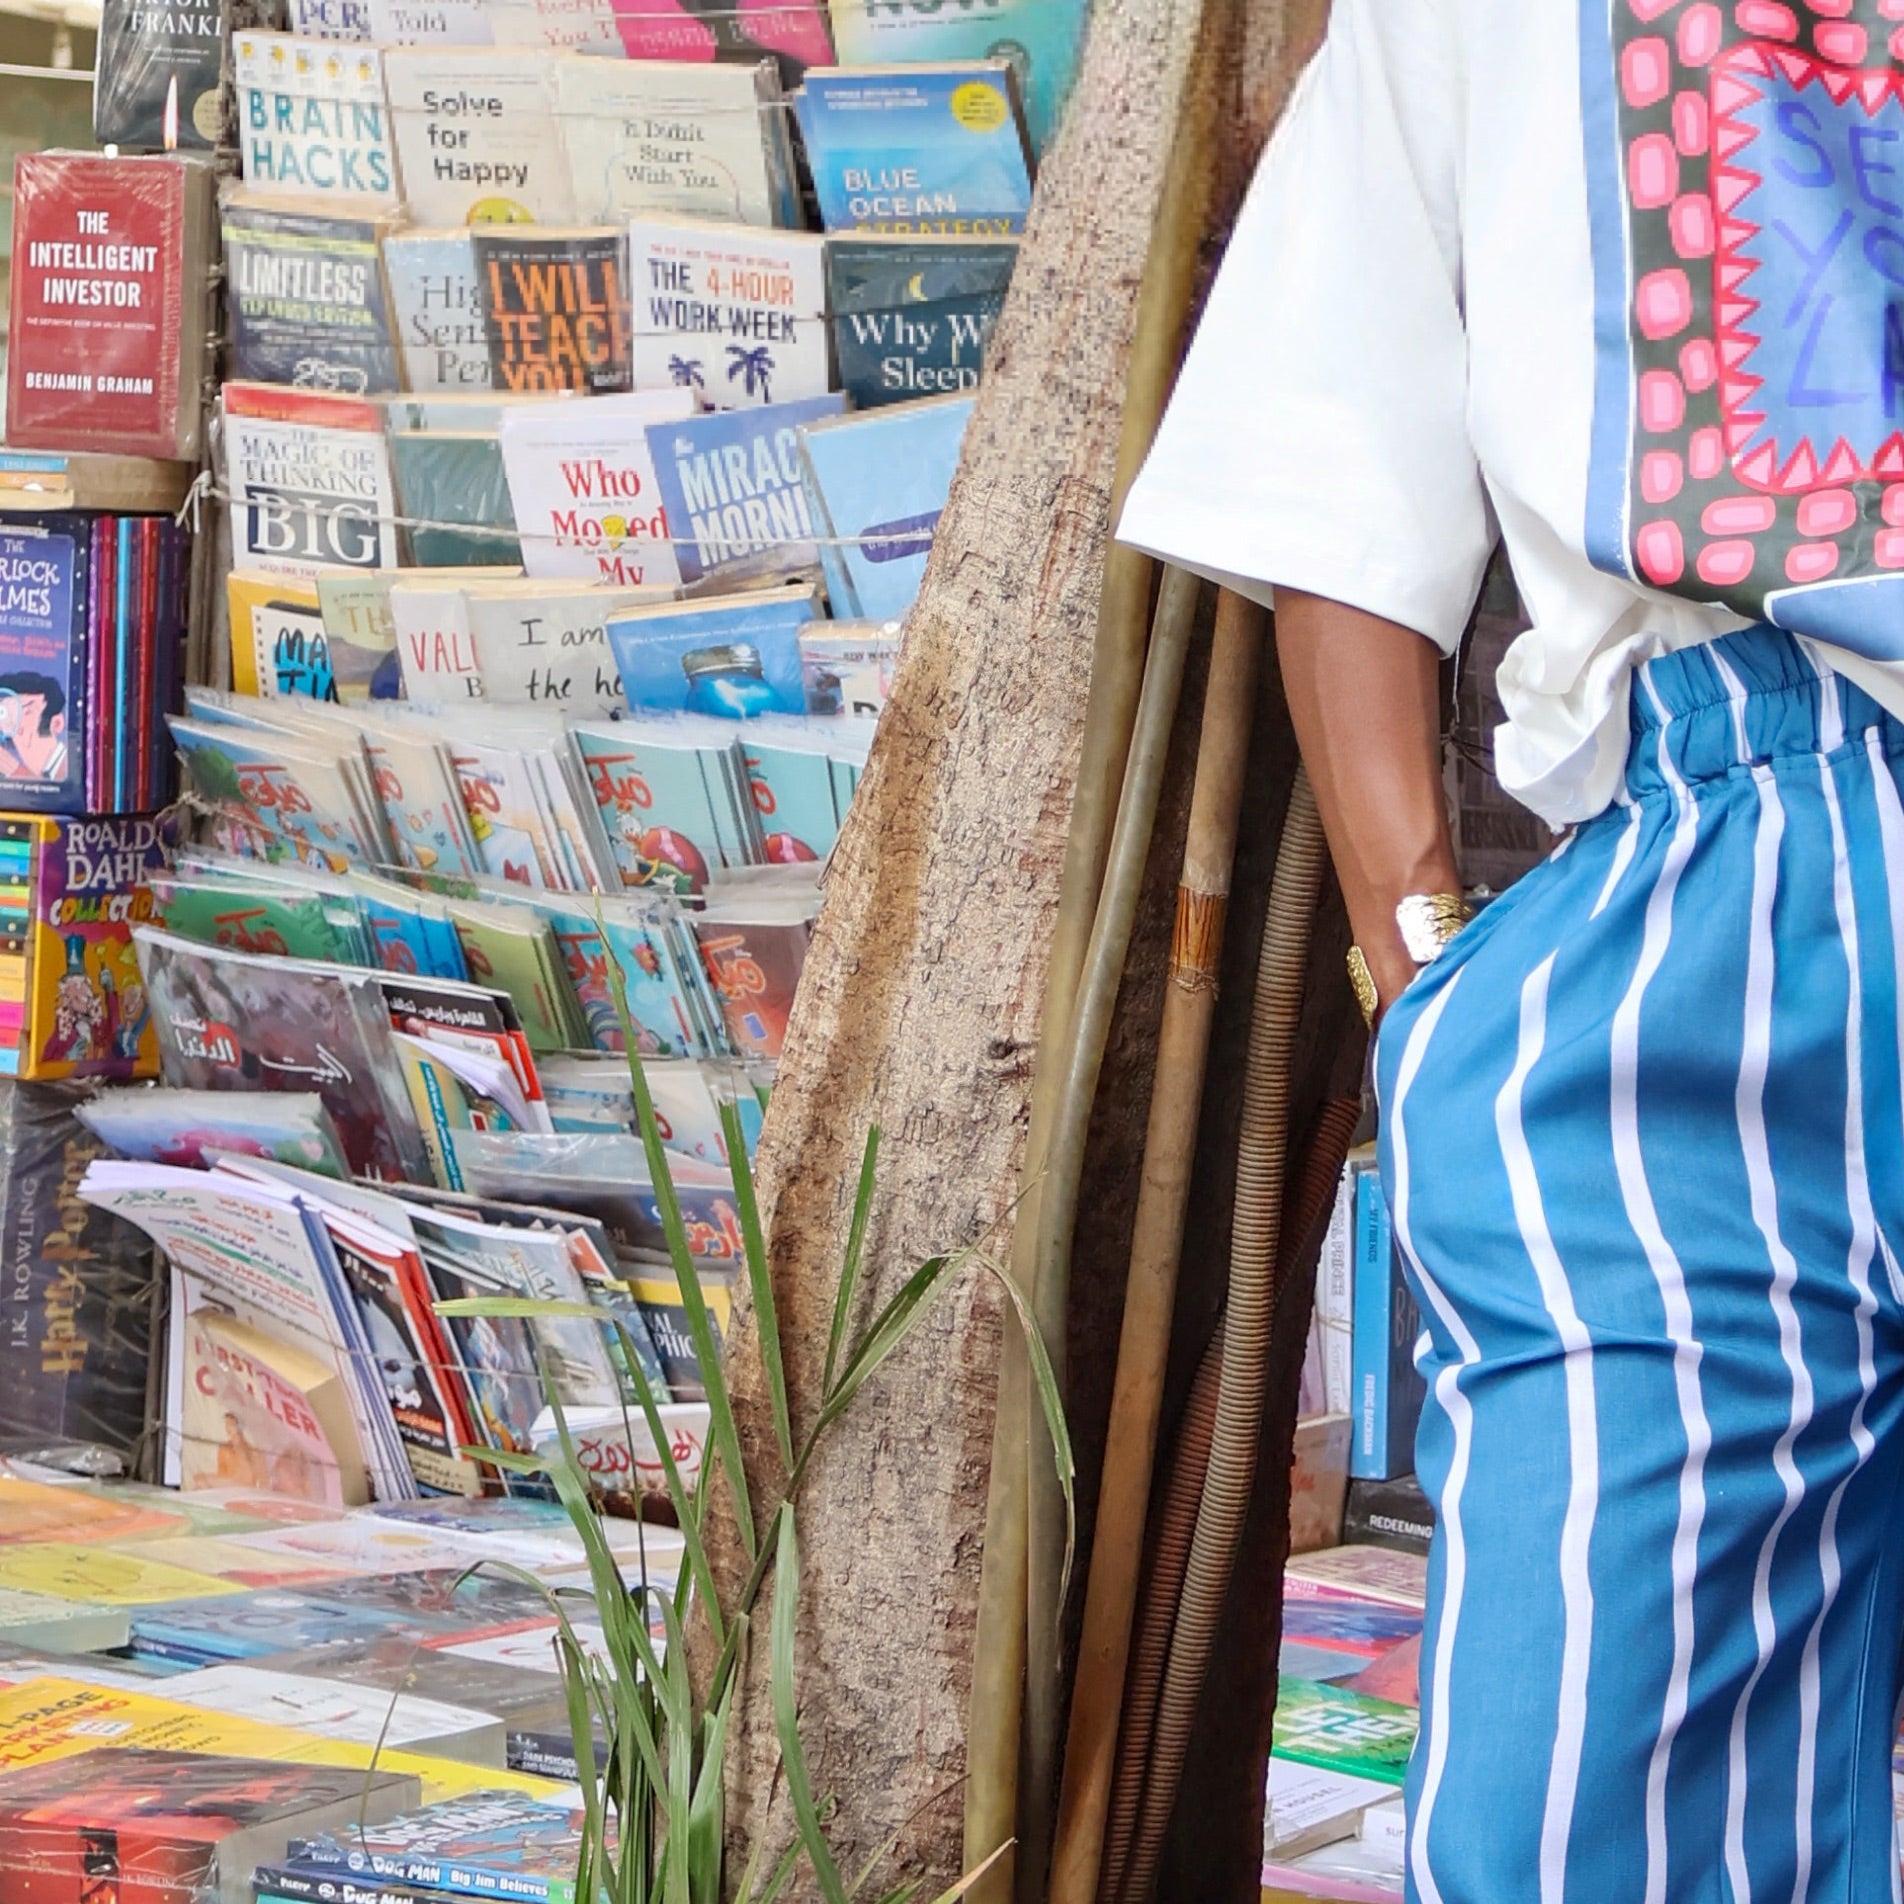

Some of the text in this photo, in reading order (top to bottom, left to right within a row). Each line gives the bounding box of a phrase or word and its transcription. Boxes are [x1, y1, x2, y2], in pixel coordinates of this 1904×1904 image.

[390, 12, 446, 33] Told
[544, 27, 588, 48] You
[248, 87, 383, 143] BRAIN
[422, 90, 504, 118] Solve
[427, 122, 470, 149] for
[643, 120, 705, 142] Didn't
[252, 137, 391, 193] HACKS
[638, 144, 693, 164] Start
[434, 157, 530, 188] Happy
[623, 165, 719, 190] With You
[844, 167, 922, 193] BLUE
[77, 210, 109, 235] THE
[849, 194, 957, 219] OCEAN
[30, 242, 158, 273] INTELLIGENT
[43, 277, 142, 308] INVESTOR
[239, 250, 368, 306] LIMITLESS
[487, 261, 507, 314] I
[647, 257, 692, 294] THE
[706, 267, 795, 306] 4-HOUR
[849, 313, 938, 355] Why
[26, 372, 153, 395] BENJAMIN GRAHAM
[501, 361, 586, 395] YOU
[881, 355, 979, 391] Sleep
[240, 435, 376, 472] MAGIC OF
[676, 426, 801, 515] MIRAC
[240, 457, 378, 497] THINKING
[558, 457, 641, 500] Who
[249, 488, 378, 564] BIG
[691, 484, 812, 568] MORNI
[5, 539, 25, 554] THE
[518, 618, 547, 647] I
[560, 626, 606, 648] am
[526, 667, 572, 701] the
[66, 820, 155, 855] ROALD
[66, 851, 151, 891] DAHL
[50, 892, 163, 927] COLLECTION
[259, 1041, 353, 1085] البيت
[1367, 1224, 1379, 1264] FRIENDS
[11, 1176, 39, 1348] J.K. ROWLING
[40, 1265, 89, 1374] Harry
[1369, 1514, 1433, 1539] REDEEMING
[522, 1750, 543, 1763] DARK
[372, 1855, 405, 1879] DOG
[407, 1862, 441, 1883] MAN
[450, 1869, 471, 1888] Big
[474, 1872, 496, 1889] Jim
[499, 1875, 549, 1897] Believes
